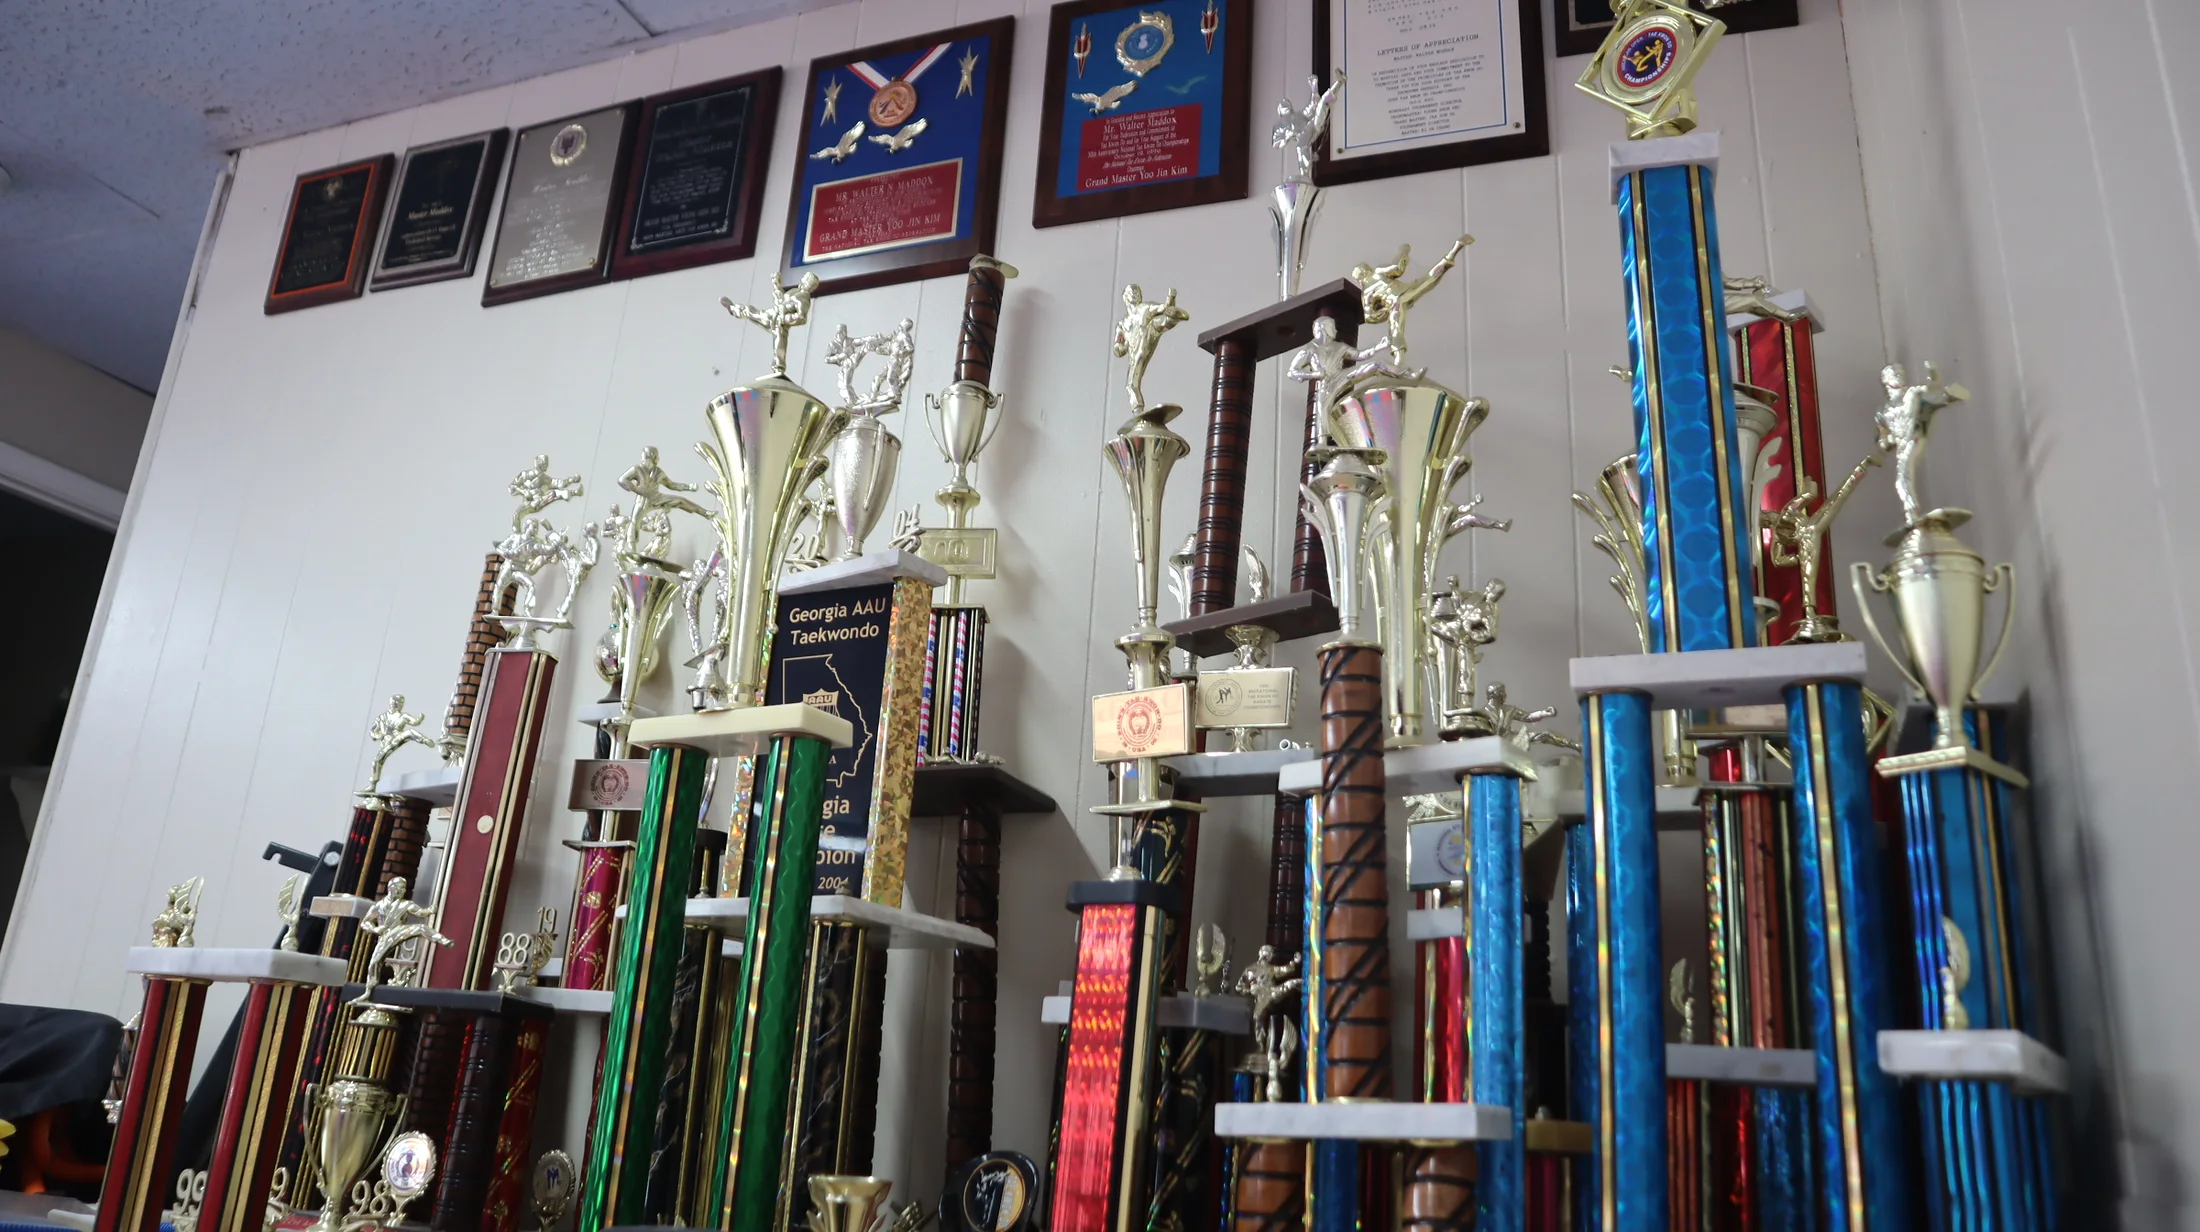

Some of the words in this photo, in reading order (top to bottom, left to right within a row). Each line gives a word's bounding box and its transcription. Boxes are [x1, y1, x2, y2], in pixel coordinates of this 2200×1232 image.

[1378, 46, 1407, 56] LETTERS
[1424, 34, 1479, 48] APPRECIATION
[1624, 52, 1672, 83] CHAMPIONSHIPS
[1104, 124, 1115, 134] Mr.
[1120, 120, 1144, 132] Walter
[1147, 115, 1176, 127] Maddox
[853, 185, 884, 199] WALTER
[898, 175, 933, 190] MADDOX
[1086, 176, 1108, 188] Grand
[1112, 172, 1136, 184] Master
[1141, 169, 1153, 180] Yoo
[1157, 167, 1167, 177] Jin
[1171, 165, 1187, 175] Kim
[820, 230, 847, 243] GRAND
[851, 223, 882, 238] MASTER
[888, 219, 903, 231] YOO
[907, 216, 921, 227] JIN
[924, 213, 941, 225] KIM
[791, 533, 819, 560] 20
[789, 603, 847, 623] Georgia
[852, 598, 886, 616] AAU
[790, 622, 879, 645] Taekwondo
[808, 694, 833, 705] AAU
[537, 906, 557, 934] 19
[498, 932, 531, 965] 88
[349, 1180, 390, 1215] 98
